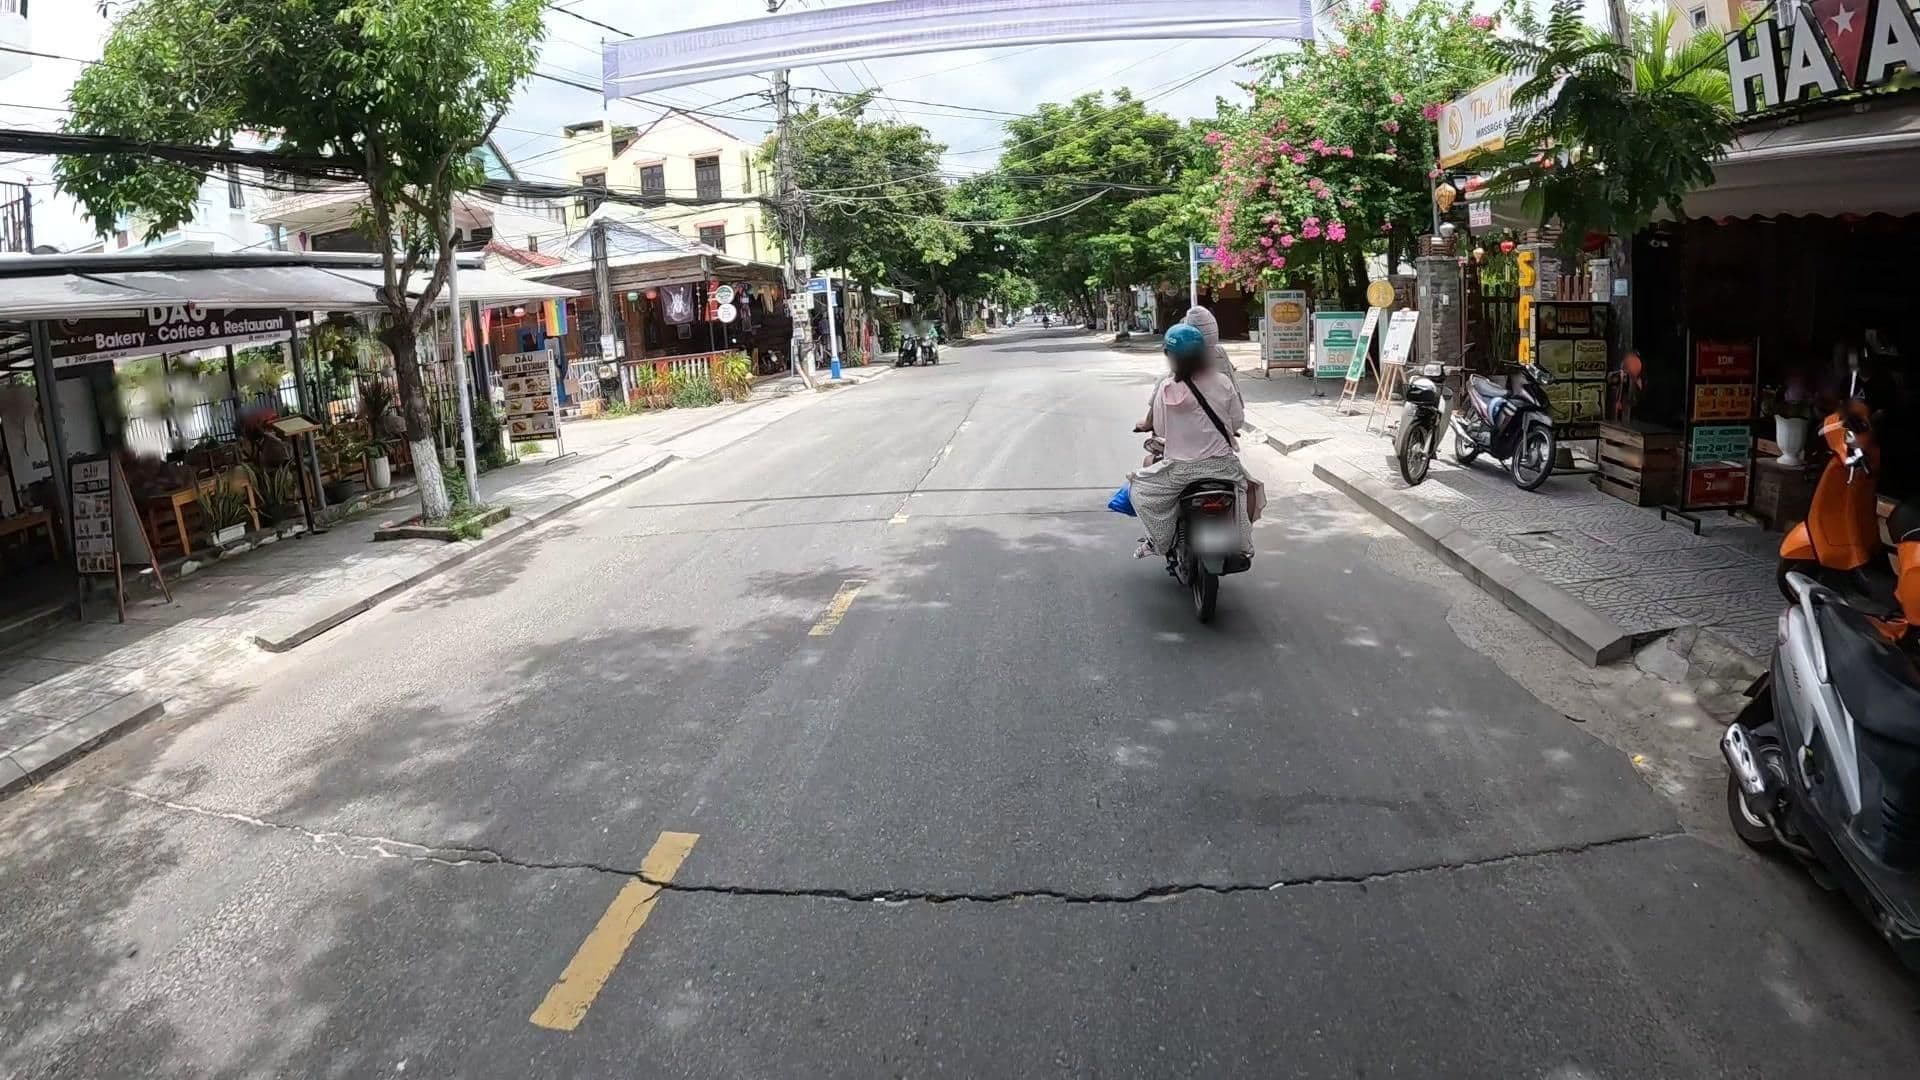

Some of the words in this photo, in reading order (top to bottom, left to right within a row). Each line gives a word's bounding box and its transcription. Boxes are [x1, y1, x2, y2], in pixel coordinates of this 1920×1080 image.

[1471, 95, 1493, 122] The
[1476, 120, 1502, 138] MASSAGE
[95, 332, 145, 350] Bakery
[158, 321, 205, 341] Coffee
[210, 321, 219, 335] &
[223, 315, 283, 334] Restaurant
